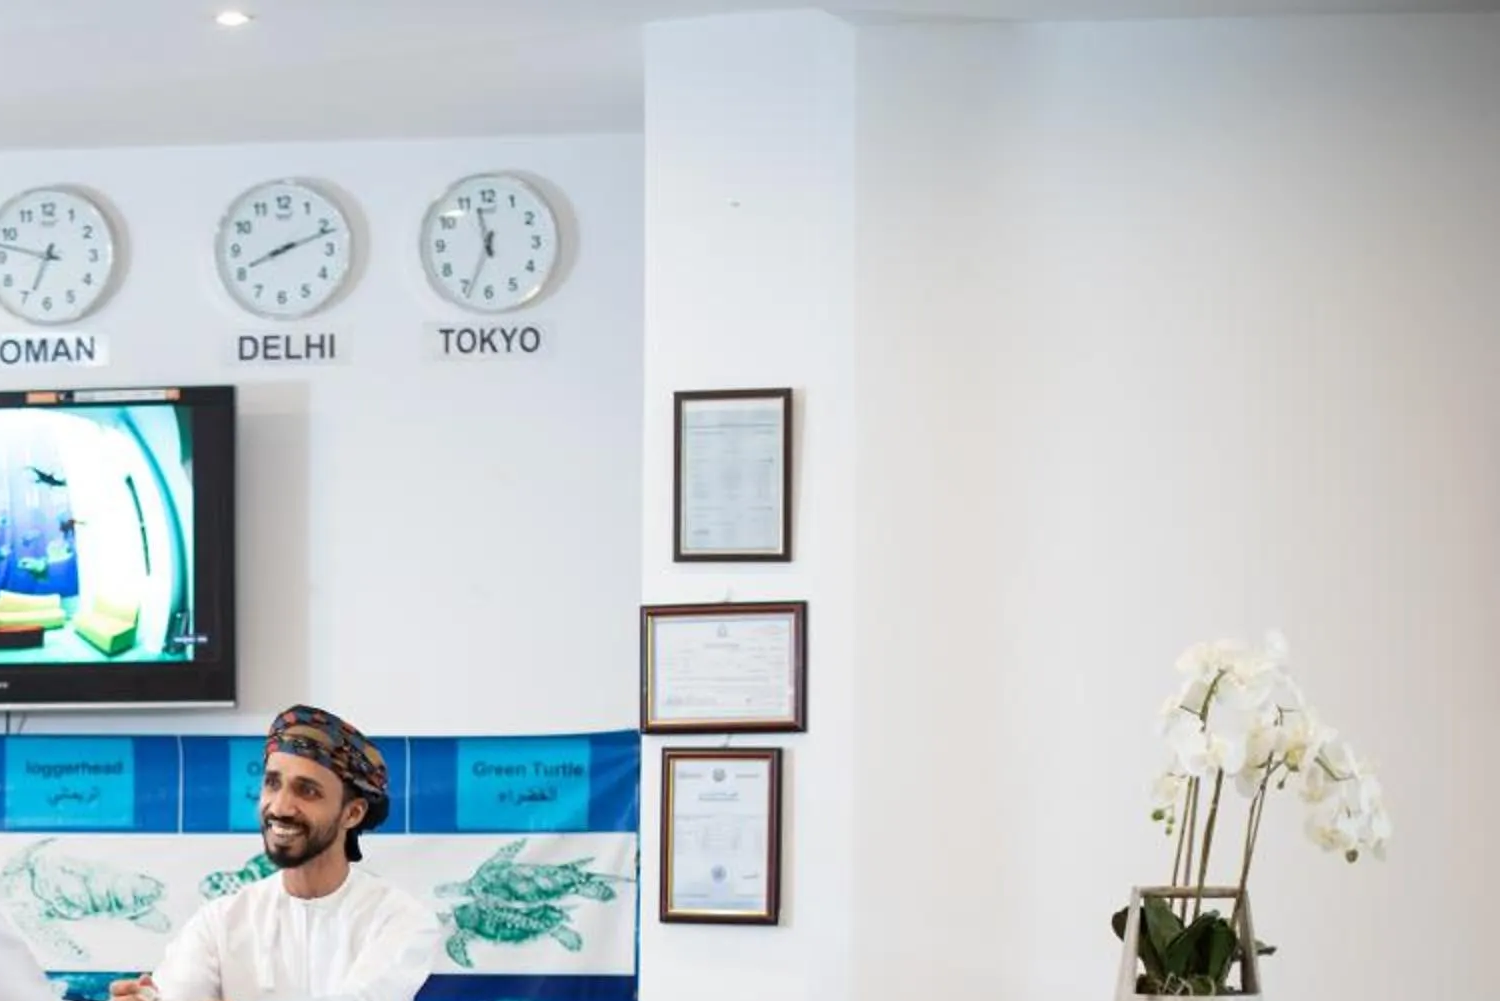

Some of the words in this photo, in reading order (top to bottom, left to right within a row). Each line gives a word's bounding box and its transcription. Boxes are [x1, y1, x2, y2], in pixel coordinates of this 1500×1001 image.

[276, 195, 292, 209] 12
[480, 188, 496, 203] 12
[40, 202, 56, 217] 12
[253, 201, 267, 217] 11
[458, 196, 471, 211] 11
[20, 209, 33, 223] 11
[439, 215, 457, 230] 10
[524, 211, 535, 226] 2
[82, 225, 93, 239] 2
[235, 220, 251, 234] 10
[318, 218, 329, 234] 2
[2, 227, 18, 241] 10
[231, 242, 241, 258] 9
[324, 242, 335, 257] 3
[435, 239, 446, 253] 9
[531, 235, 541, 250] 3
[88, 248, 99, 262] 3
[237, 266, 247, 281] 8
[317, 265, 328, 279] 4
[442, 262, 453, 278] 8
[525, 260, 535, 273] 4
[3, 273, 13, 287] 8
[82, 272, 92, 286] 4
[460, 278, 470, 294] 7
[508, 277, 518, 292] 5
[19, 290, 30, 305] 7
[66, 289, 76, 304] 5
[253, 283, 263, 298] 7
[277, 290, 288, 305] 6
[301, 283, 311, 298] 5
[484, 284, 494, 300] 6
[42, 296, 53, 311] 6
[238, 333, 336, 361] DELHI
[437, 326, 541, 354] TOKYO
[0, 335, 95, 365] OMAN
[472, 760, 527, 777] Green
[533, 760, 584, 777] Turtle
